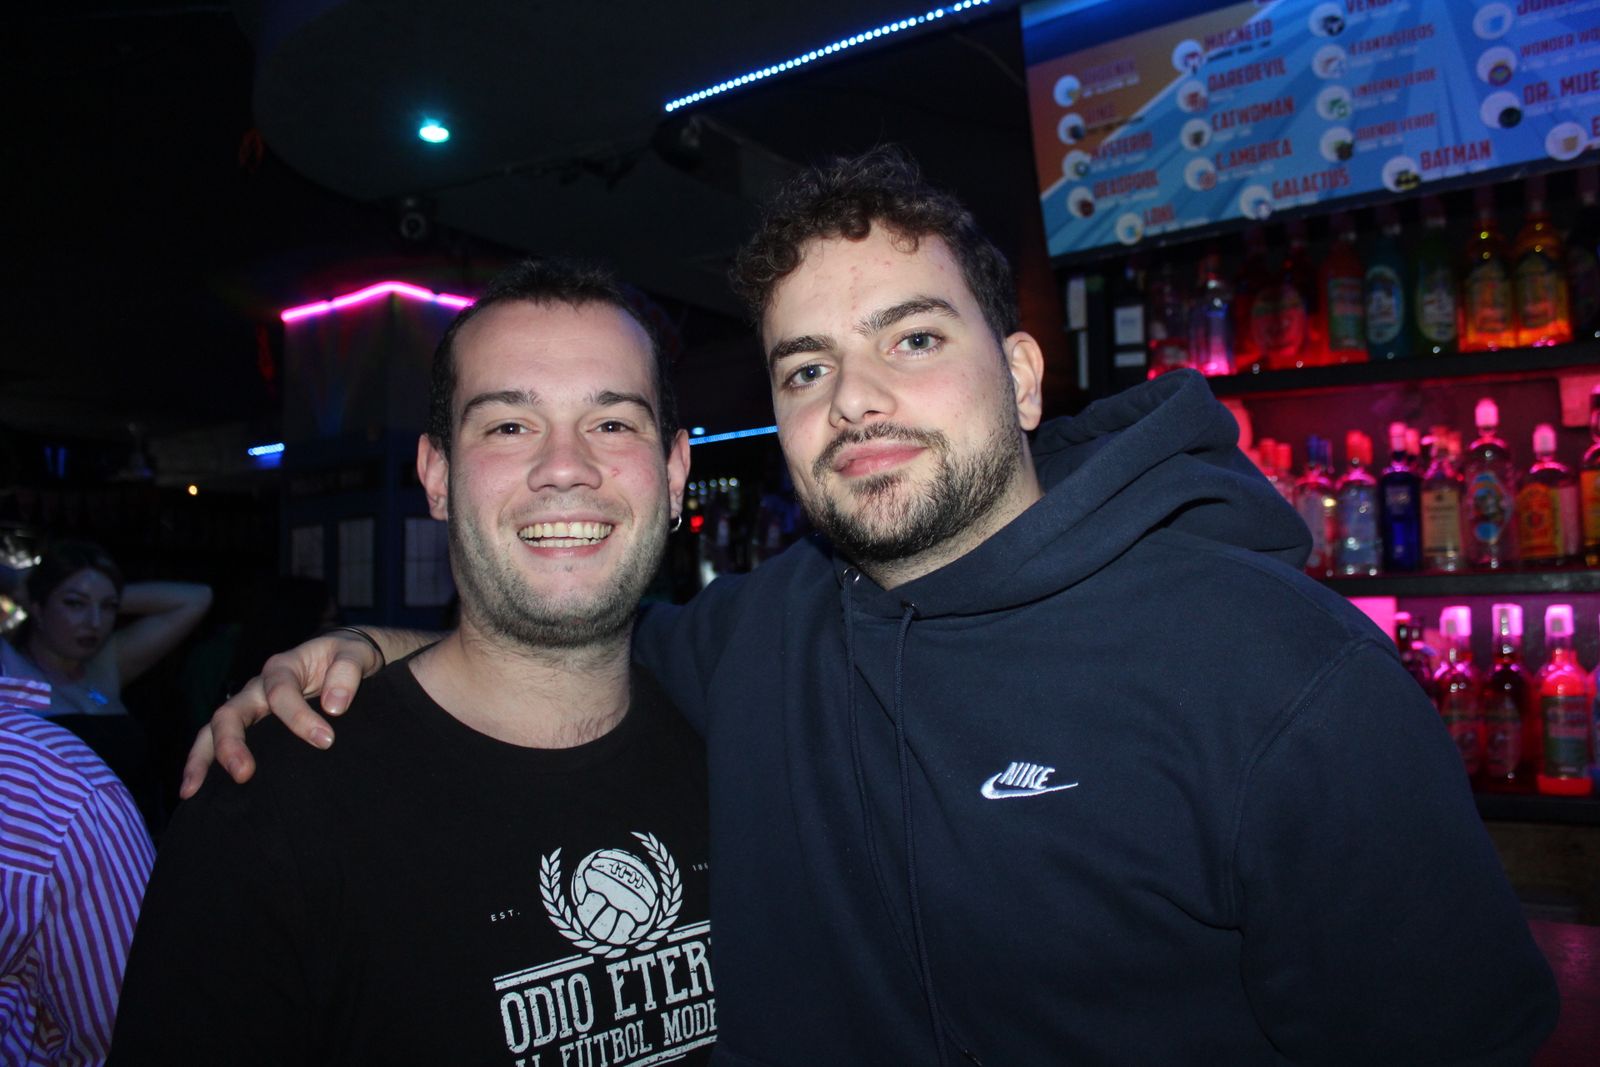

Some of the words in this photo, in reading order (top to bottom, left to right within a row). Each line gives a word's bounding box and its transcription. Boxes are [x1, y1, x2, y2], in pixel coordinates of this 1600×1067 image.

[1205, 19, 1273, 50] MAGNETO
[1520, 33, 1574, 58] WONDER
[1207, 57, 1286, 91] DAREDEVIL
[1211, 95, 1295, 131] CATWOMAN
[1419, 139, 1492, 172] BATMAN
[1272, 167, 1349, 200] GALACTUS
[998, 761, 1056, 790] NIKE
[490, 909, 521, 922] EST.
[500, 972, 595, 1054] ODIO
[605, 937, 715, 1021] ETER
